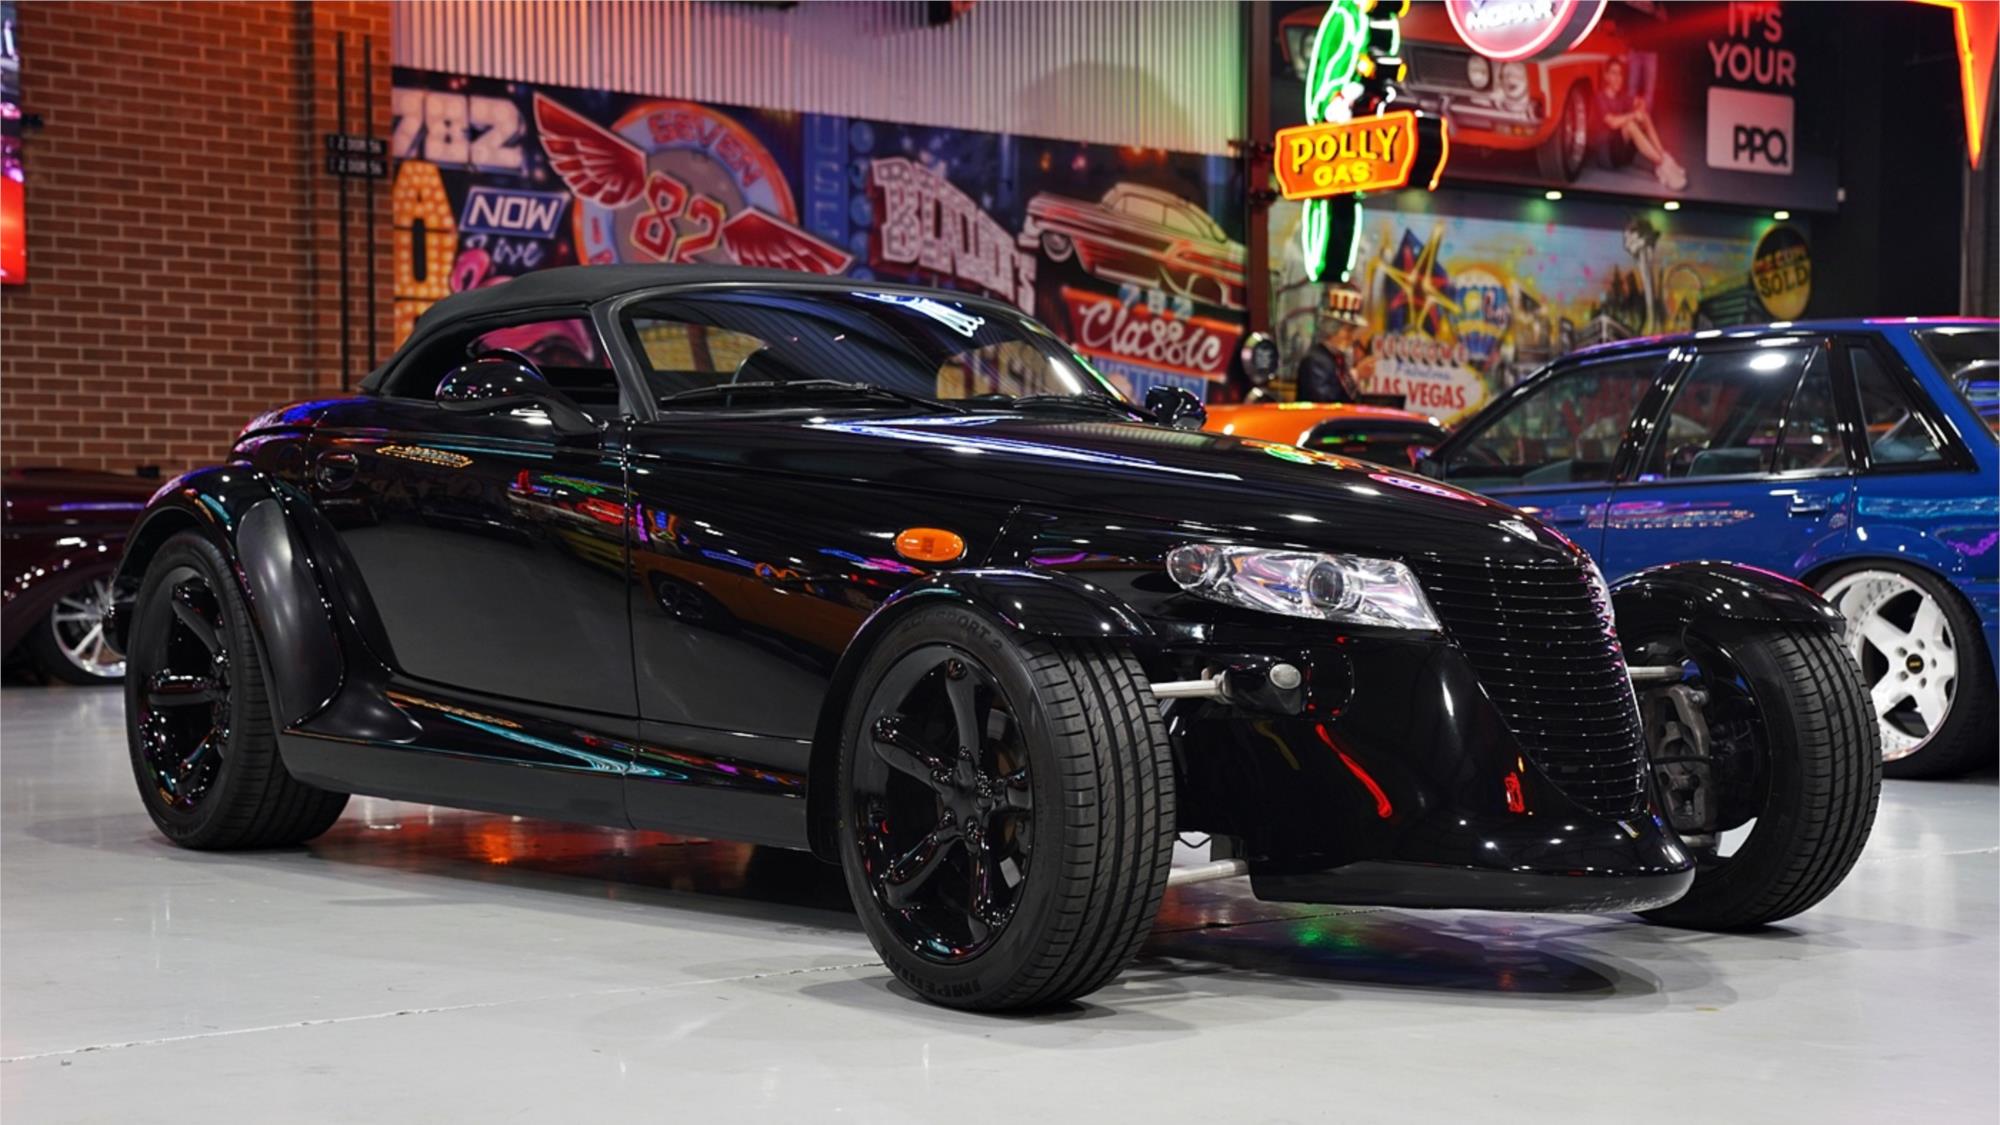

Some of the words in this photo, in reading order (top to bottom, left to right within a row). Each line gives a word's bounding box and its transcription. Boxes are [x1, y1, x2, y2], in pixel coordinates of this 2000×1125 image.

[1728, 1, 1782, 43] IT'S
[1708, 39, 1796, 87] YOUR
[391, 86, 530, 170] 782
[1289, 125, 1399, 173] POLLY
[1733, 123, 1788, 168] PPQ
[1313, 160, 1371, 187] GAS
[468, 194, 559, 232] NOW
[627, 169, 728, 264] 82
[1758, 265, 1808, 299] SOLD
[1406, 378, 1468, 412] VEGAS
